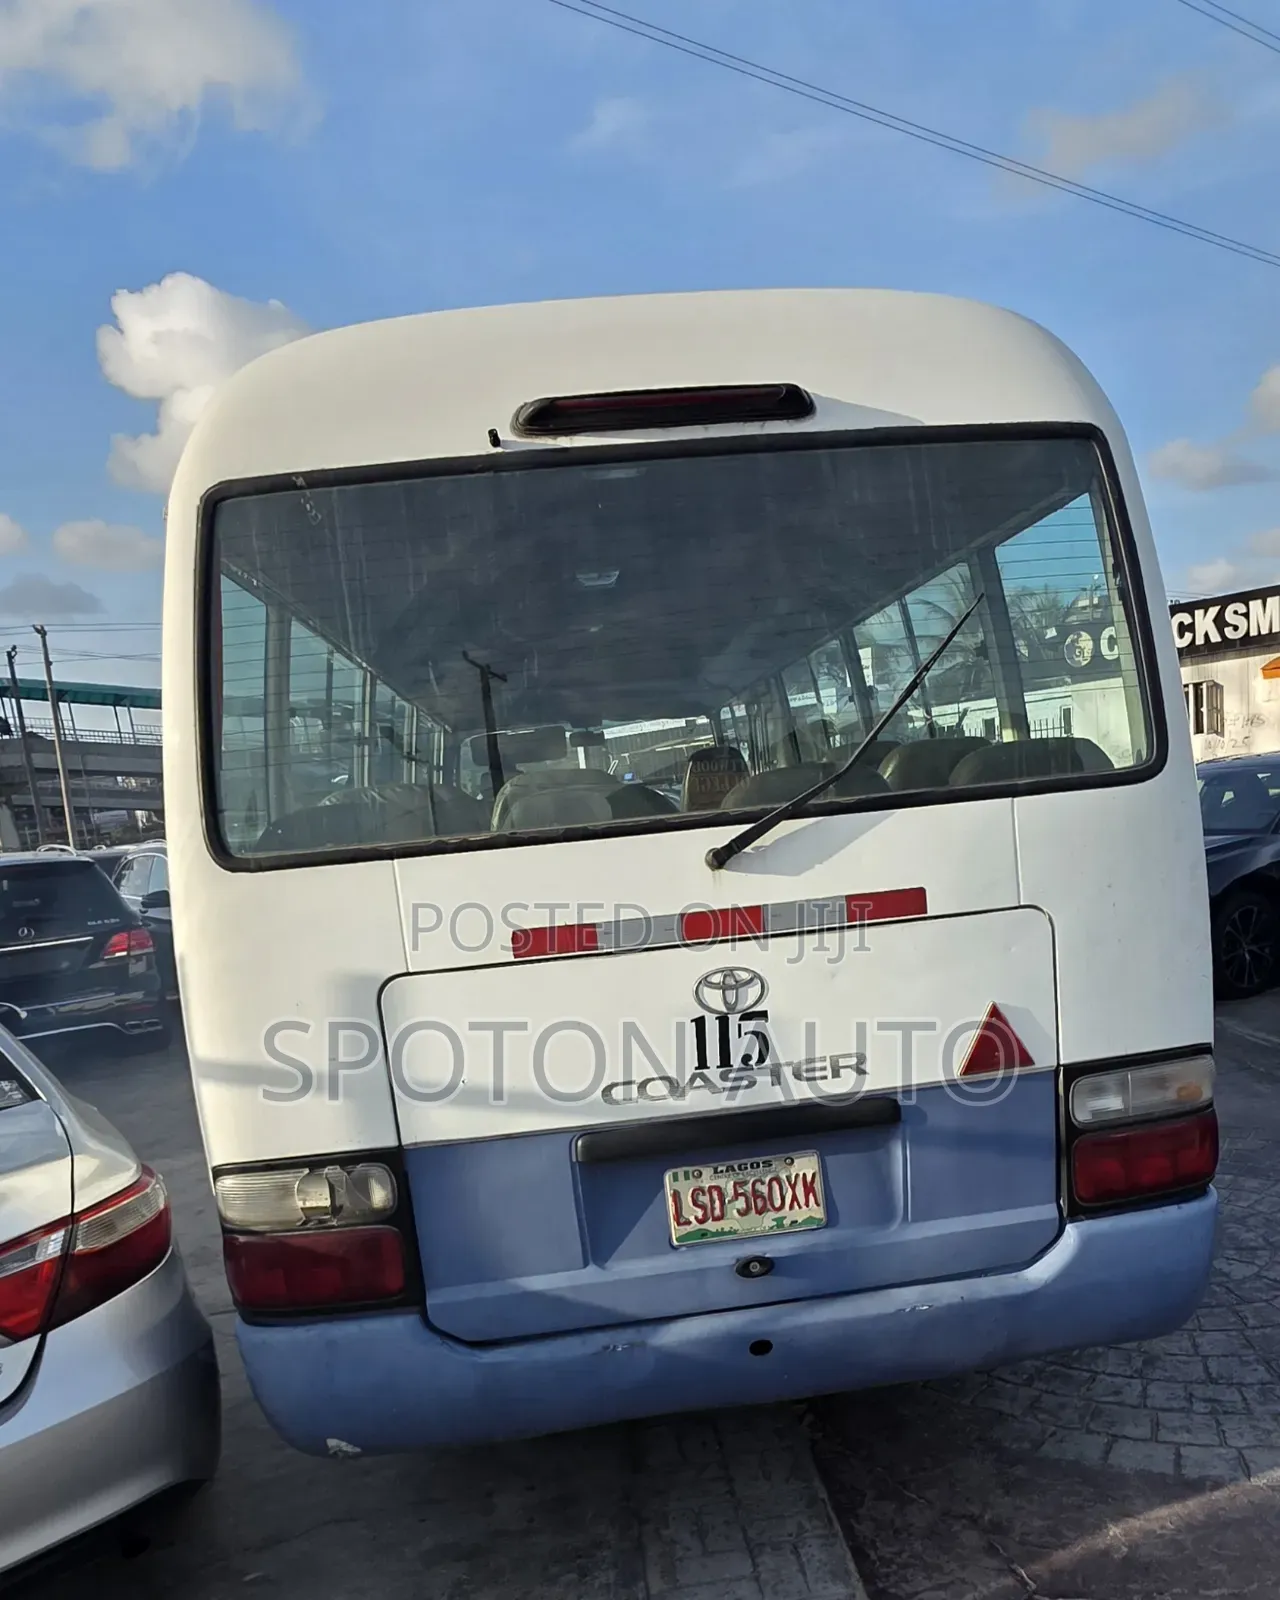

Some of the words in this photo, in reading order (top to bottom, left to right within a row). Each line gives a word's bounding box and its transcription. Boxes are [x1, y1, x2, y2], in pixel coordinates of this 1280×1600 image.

[1171, 596, 1280, 648] CKSM
[690, 1010, 770, 1071] 115
[601, 1052, 870, 1106] COASTER
[713, 1160, 773, 1175] LAGOS
